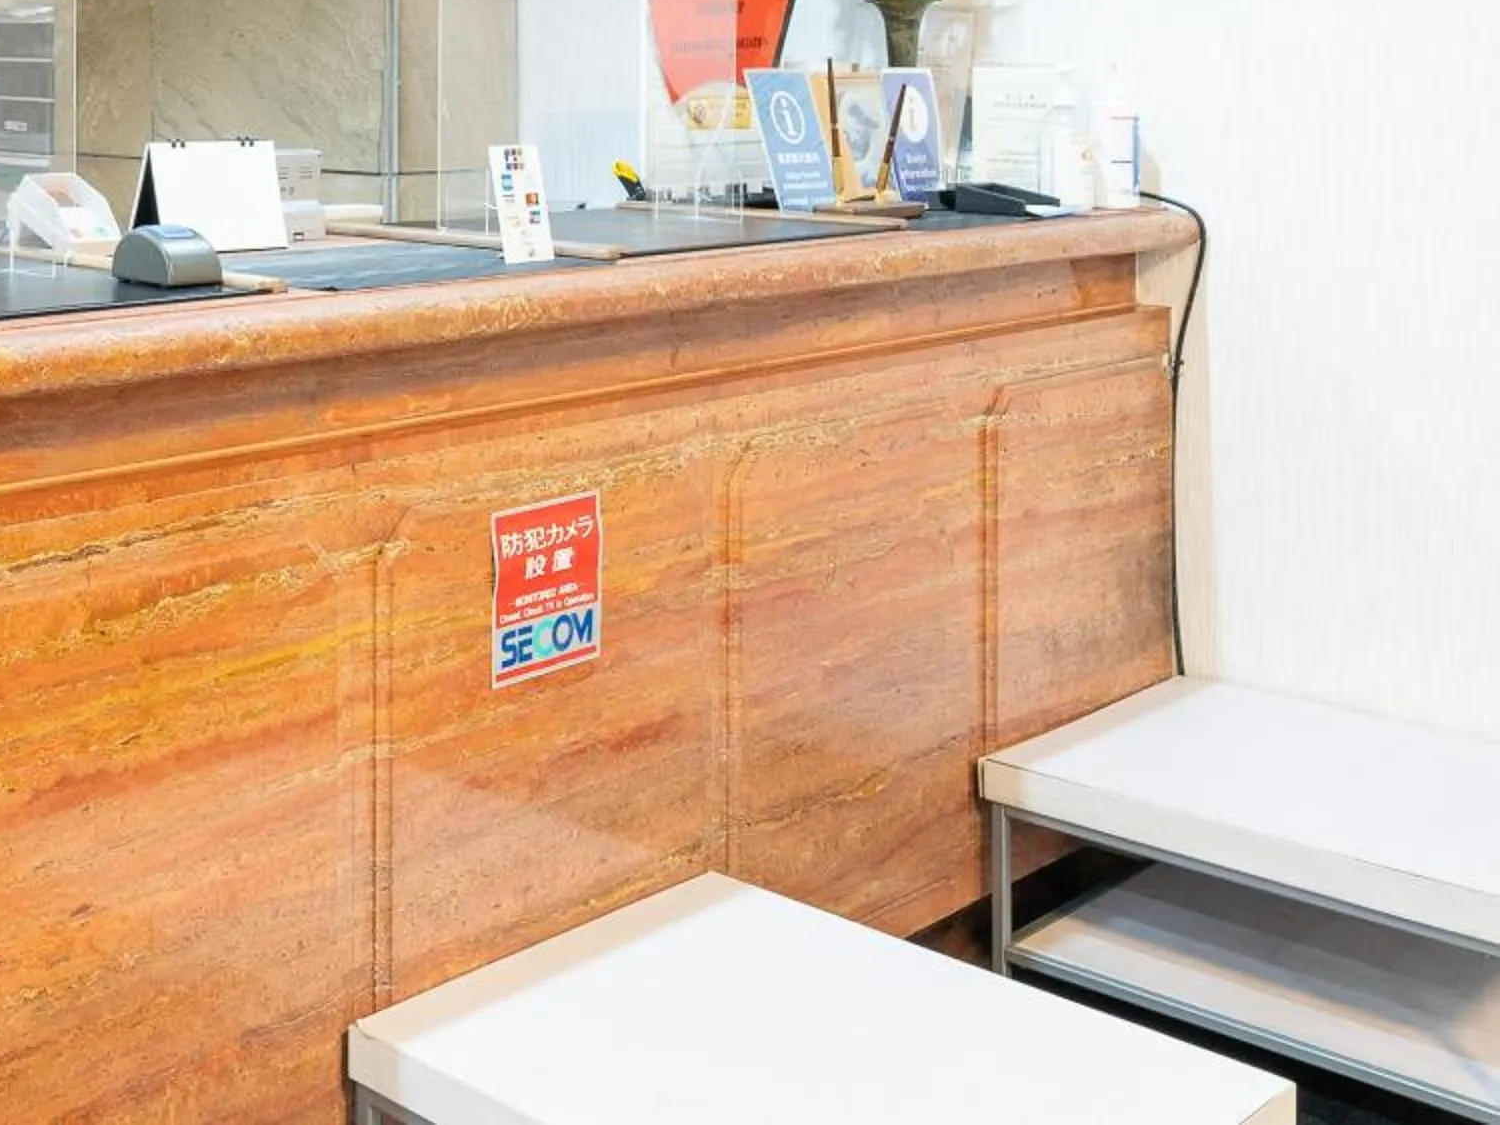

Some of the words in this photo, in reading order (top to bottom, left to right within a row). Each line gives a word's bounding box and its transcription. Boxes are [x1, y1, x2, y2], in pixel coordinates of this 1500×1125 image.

[500, 515, 594, 558] 防犯カメラ
[501, 608, 593, 667] SECOM
